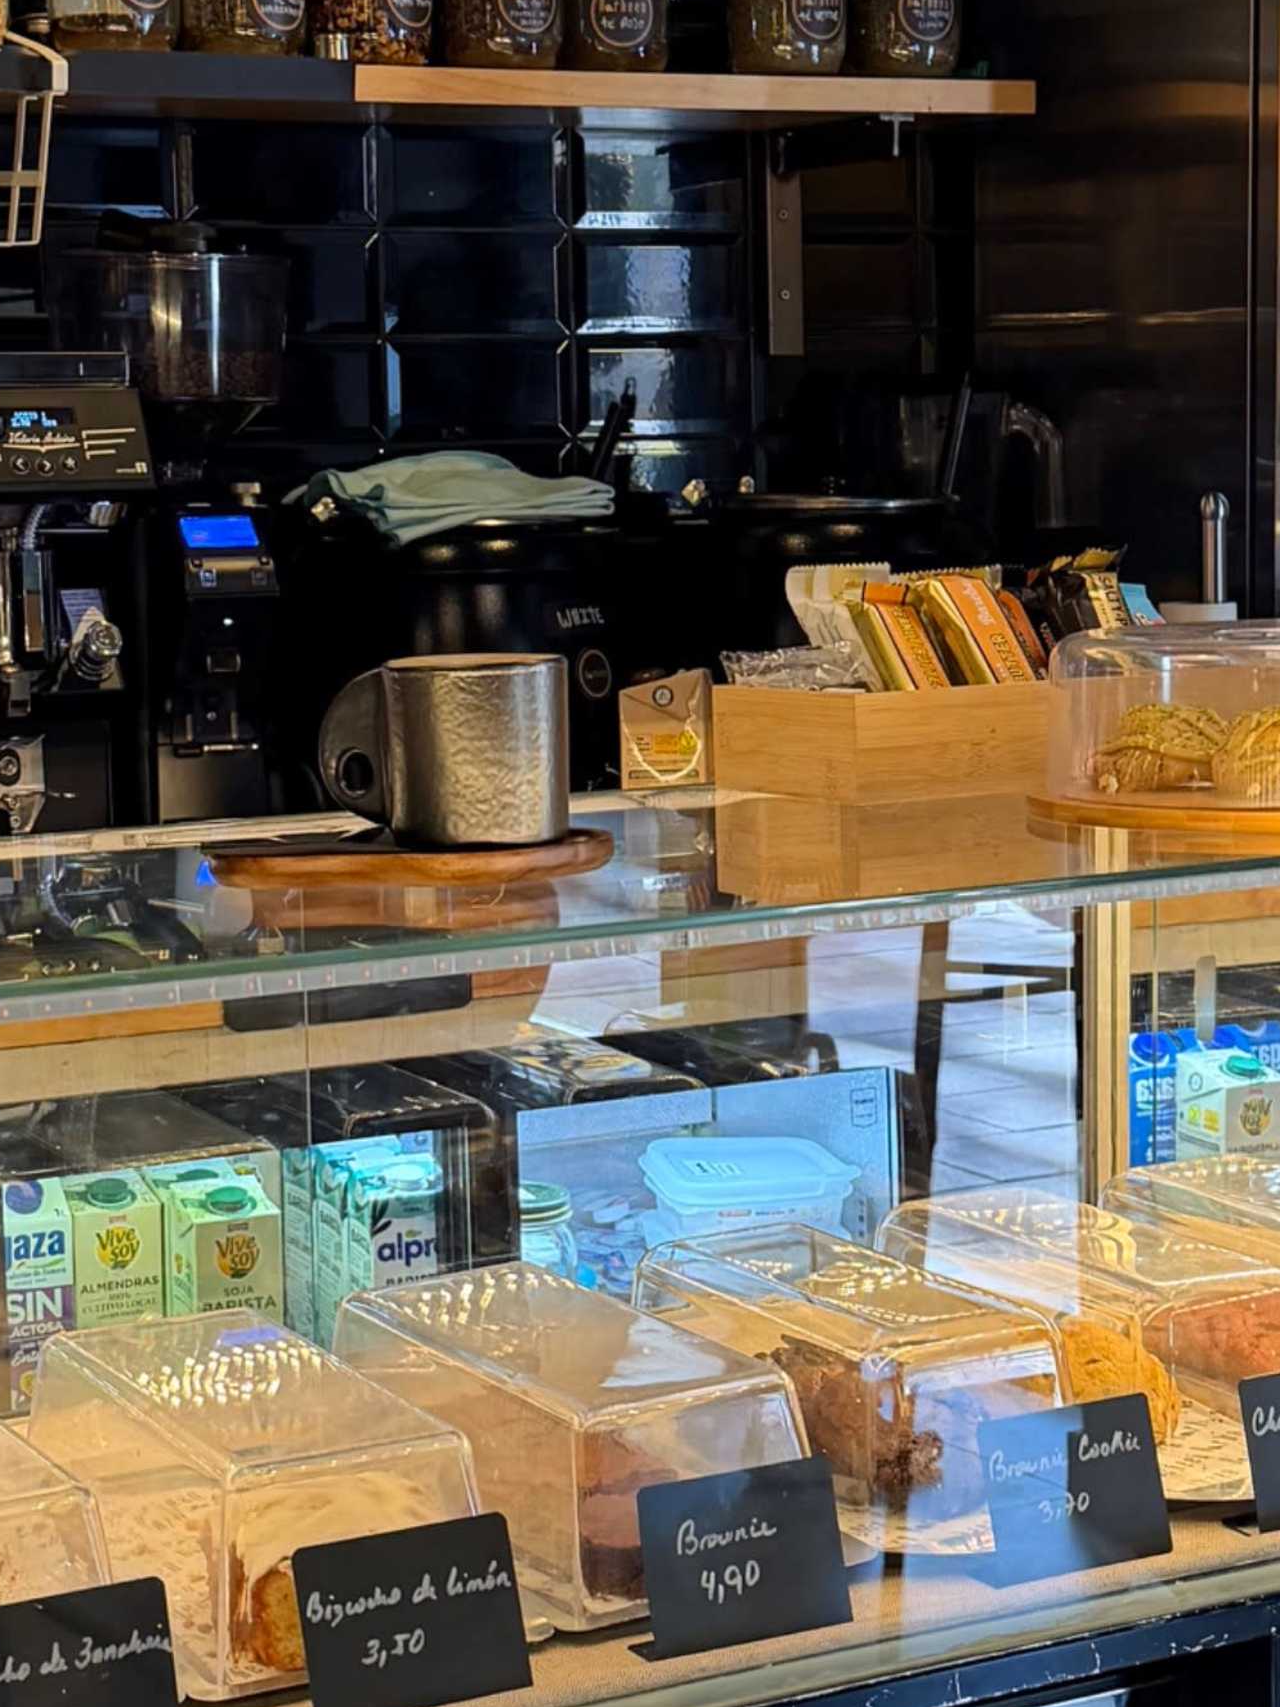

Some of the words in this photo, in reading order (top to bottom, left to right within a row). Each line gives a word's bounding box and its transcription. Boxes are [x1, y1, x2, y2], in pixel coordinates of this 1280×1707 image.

[96, 1225, 136, 1250] Vive
[110, 1239, 140, 1263] soy
[216, 1235, 257, 1259] Vive
[377, 1231, 440, 1267] alpr
[230, 1248, 261, 1269] soy
[80, 1275, 160, 1295] ALMENDRAS
[223, 1284, 255, 1296] SOJA
[7, 1289, 63, 1326] SIN
[987, 1448, 1069, 1484] Brownie
[1077, 1429, 1142, 1462] Cookie
[1037, 1492, 1091, 1525] 3,70
[675, 1518, 778, 1557] Brownie
[410, 1573, 439, 1603] de
[699, 1559, 762, 1606] 4,90
[39, 1641, 68, 1674] de
[360, 1628, 426, 1670] 3,50
